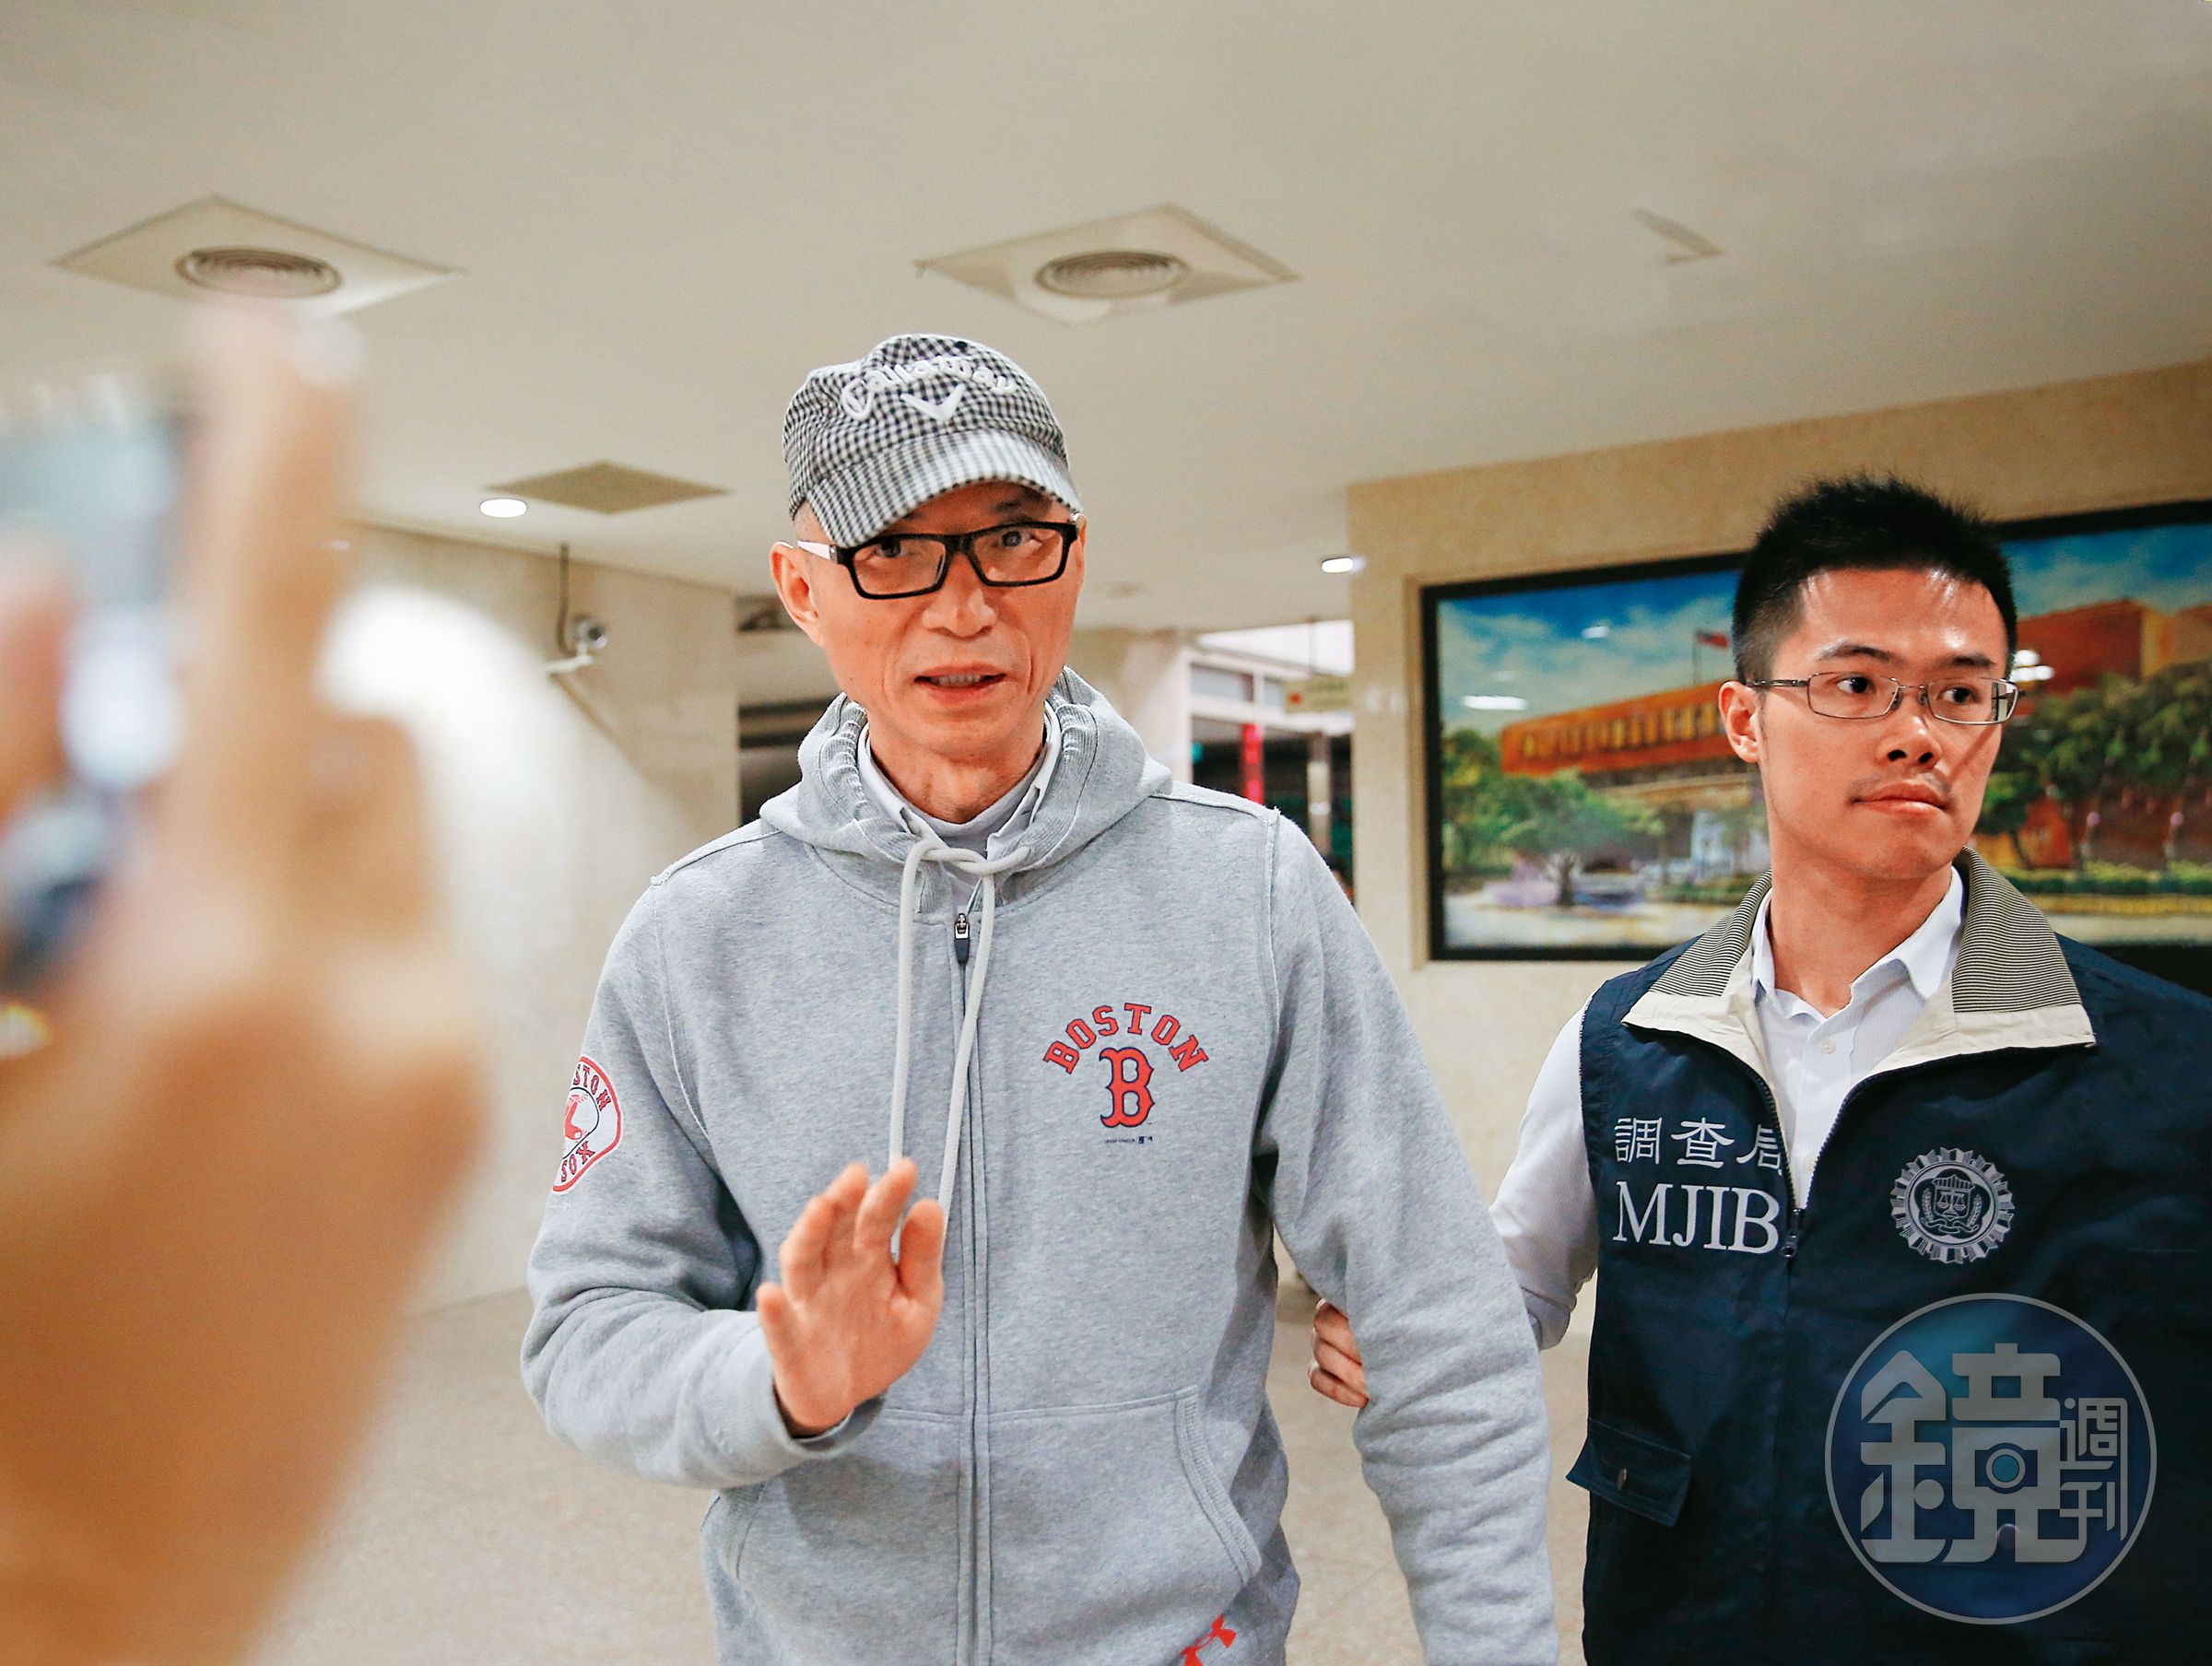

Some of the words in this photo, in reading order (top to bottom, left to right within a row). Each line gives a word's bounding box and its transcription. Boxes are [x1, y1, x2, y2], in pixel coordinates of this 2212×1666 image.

[1042, 1003, 1209, 1074] BOSTON
[572, 1063, 612, 1111] STON
[1099, 1047, 1155, 1128] B
[560, 1140, 595, 1183] SOX
[1614, 1117, 1783, 1176] 調查局
[1612, 1180, 1781, 1255] MJIB
